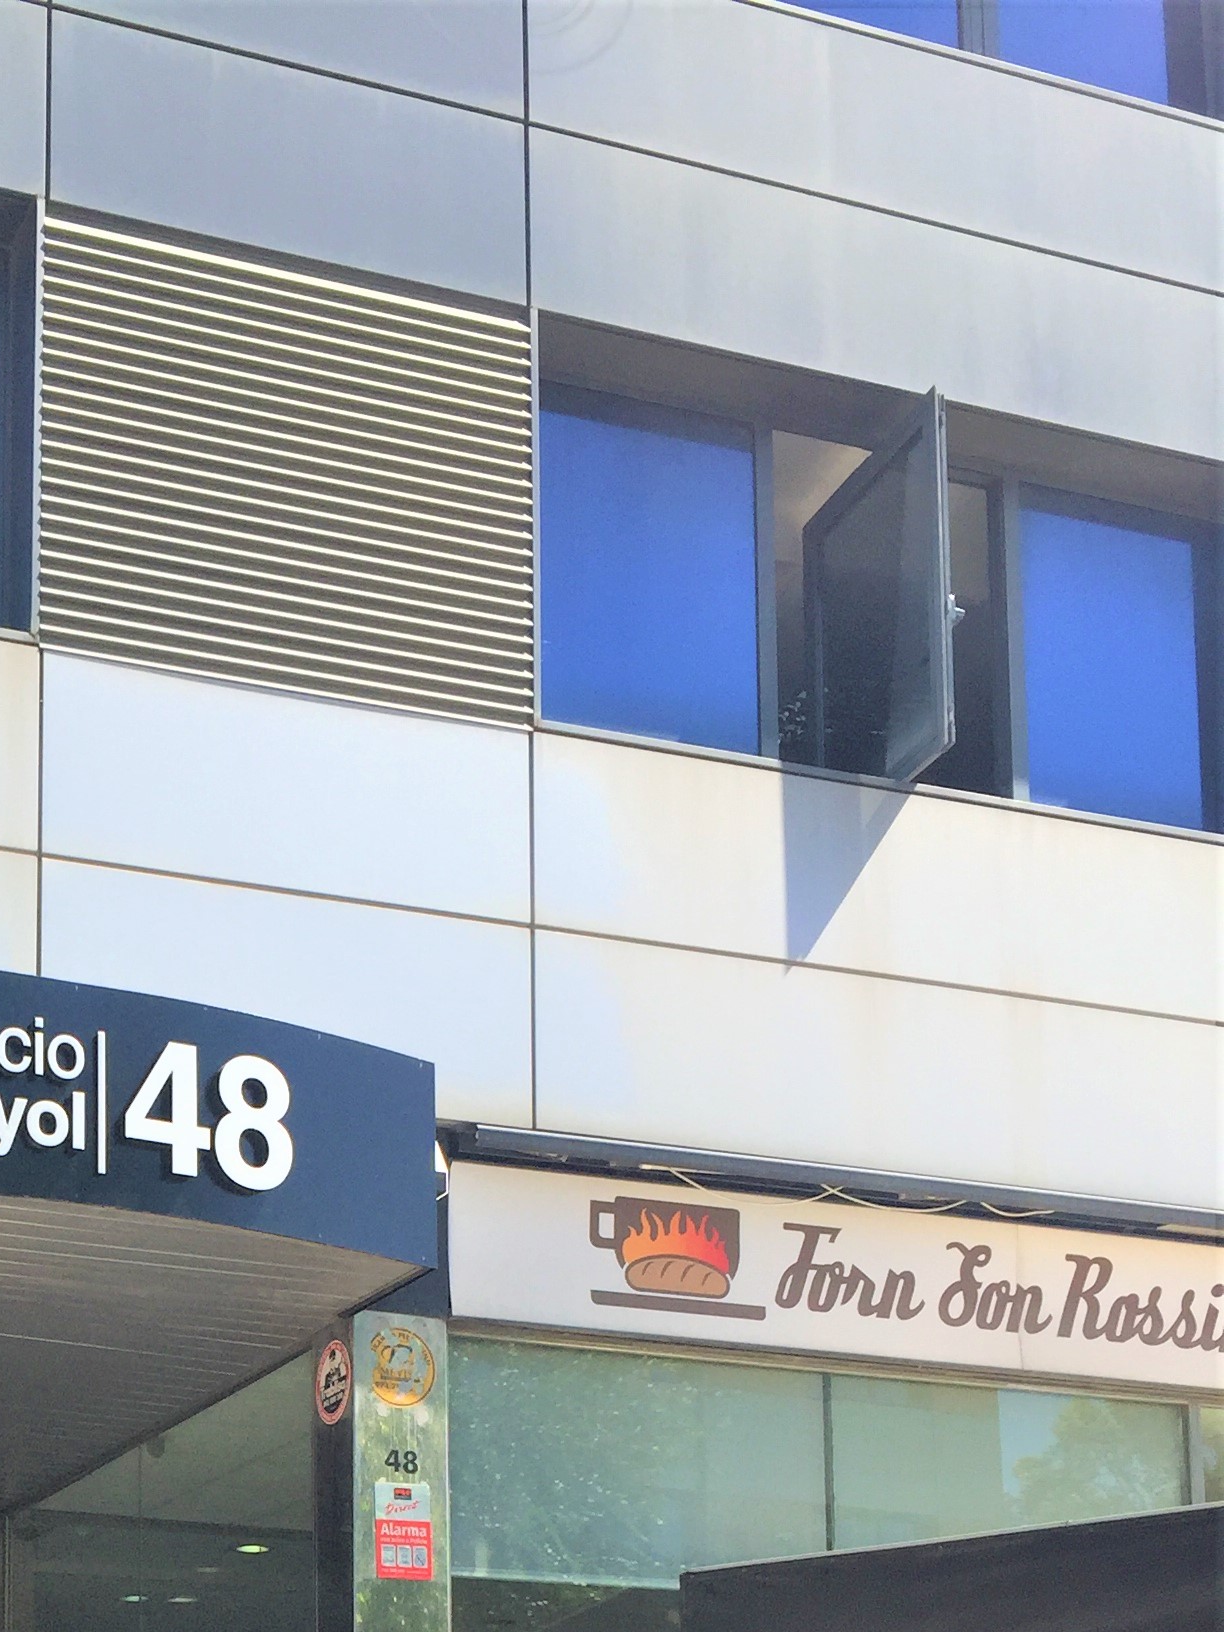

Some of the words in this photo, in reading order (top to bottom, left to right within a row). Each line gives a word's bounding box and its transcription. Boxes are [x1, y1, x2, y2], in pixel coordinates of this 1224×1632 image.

[123, 1040, 294, 1192] 48
[775, 1221, 925, 1321] Forn
[937, 1241, 1053, 1335] Son
[1056, 1253, 1224, 1353] Rossi
[384, 1449, 419, 1475] 48
[380, 1522, 428, 1538] Alarma
